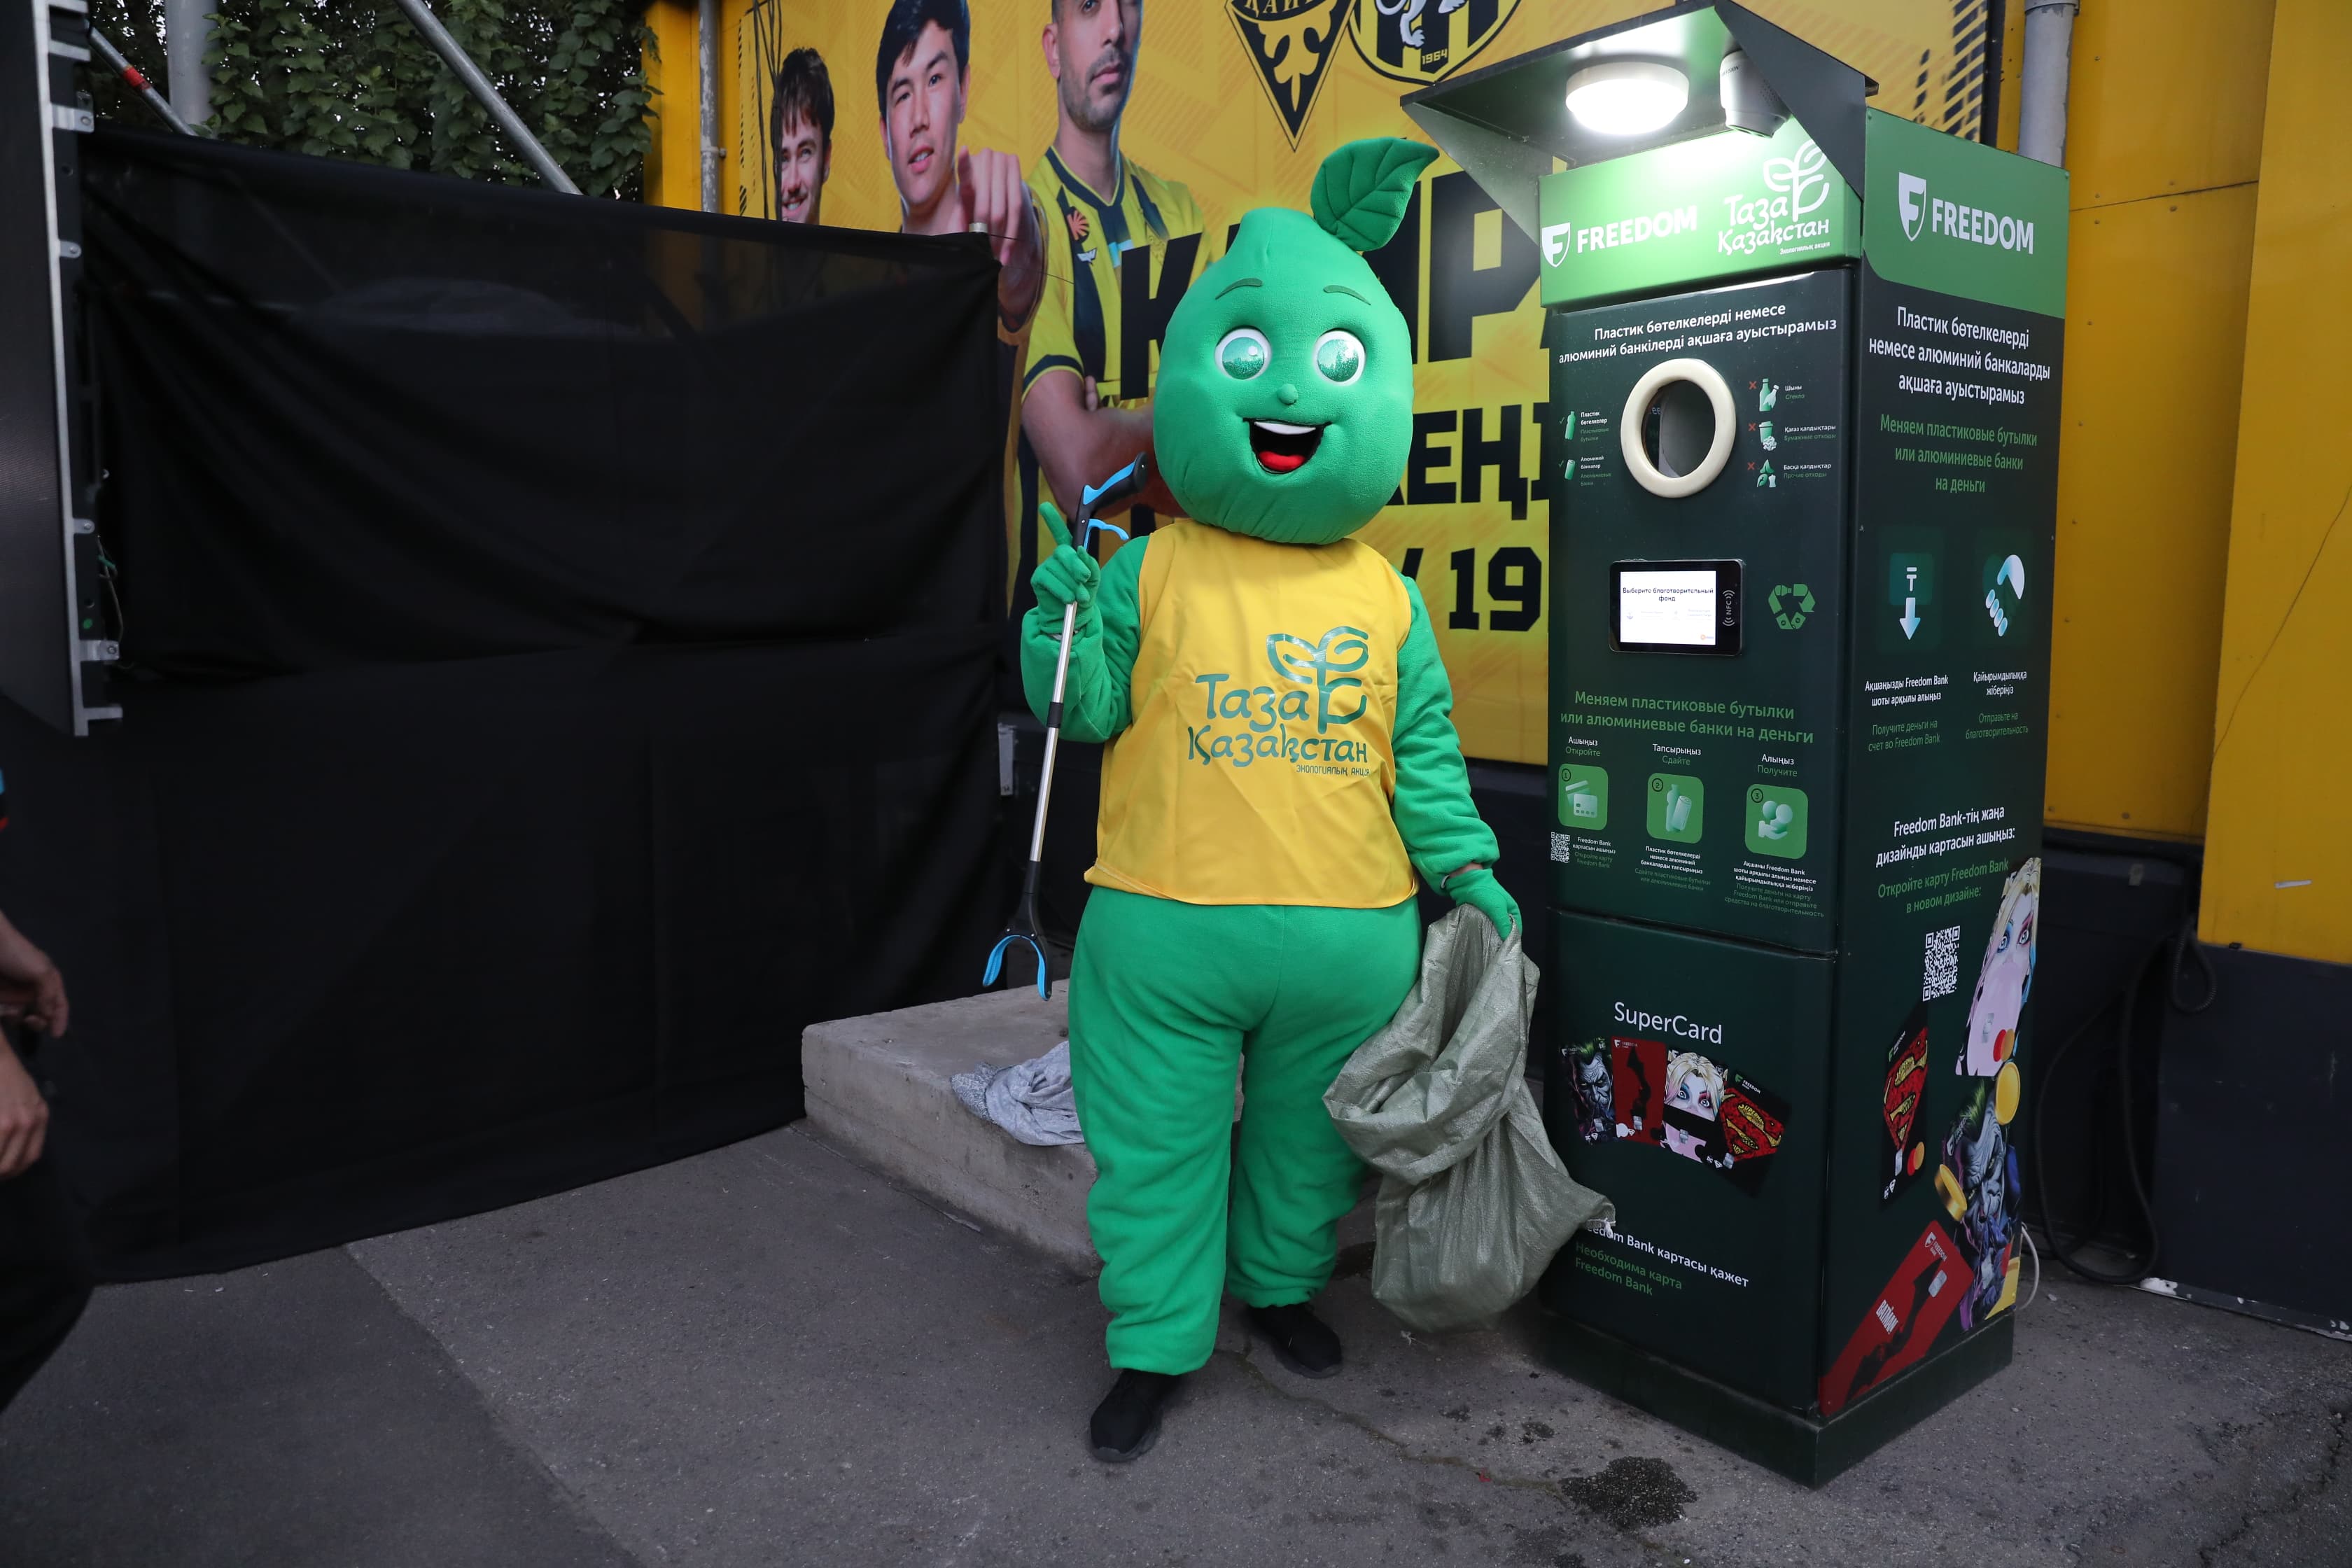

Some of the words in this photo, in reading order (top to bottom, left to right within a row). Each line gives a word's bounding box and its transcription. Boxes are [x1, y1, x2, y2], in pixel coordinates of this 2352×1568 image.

[1422, 48, 1448, 64] 1964
[1724, 195, 1788, 230] Таза
[1577, 206, 1698, 253] FREEDOM
[1718, 218, 1829, 255] Қазақстан
[1932, 197, 2033, 255] FREEDOM
[1595, 325, 1644, 341] Пластик
[1647, 309, 1732, 334] бөтелкелерді
[1735, 304, 1786, 321] немесе
[1897, 306, 1948, 335] Пластик
[1952, 316, 2029, 349] бөтелкелерді
[1559, 344, 1616, 363] алюминий
[1620, 337, 1684, 356] банкілерді
[1687, 331, 1733, 348] ақшаға
[1736, 318, 1837, 343] ауыстырамыз
[1869, 337, 1915, 358] немесе
[1918, 345, 1982, 369] алюминий
[1984, 351, 2050, 381] банкаларды
[1898, 374, 1942, 394] ақшаға
[1945, 381, 2024, 405] ауыстырамыз
[1880, 414, 1924, 435] Меняем
[1926, 422, 1995, 442] пластиковые
[1997, 427, 2038, 447] бутылки
[1895, 447, 1915, 462] или
[1917, 449, 1992, 468] алюминиевые
[1994, 452, 2023, 470] банки
[1935, 477, 1947, 491] на
[1950, 478, 1985, 493] деньги
[1865, 679, 1904, 692] Ақшаңызды
[1905, 675, 1933, 688] Freedom
[1933, 674, 1949, 686] Bank
[1973, 670, 2027, 684] Қайырымдылыққа
[1195, 673, 1310, 732] Таза
[1871, 696, 1890, 707] шоты
[1891, 693, 1917, 706] арқылы
[1917, 692, 1941, 702] алыңыз
[1986, 685, 2014, 697] жіберіңіз
[1574, 690, 1628, 708] Меняем
[1632, 697, 1726, 714] пластиковые
[1730, 701, 1795, 720] бутылки
[1560, 712, 1583, 725] или
[1586, 713, 1686, 732] алюминиевые
[1690, 720, 1733, 737] банки
[1737, 724, 1754, 738] на
[1758, 728, 1814, 745] деньги
[1872, 724, 1905, 737] Получите
[1906, 720, 1929, 734] деньги
[1930, 720, 1938, 729] на
[1978, 712, 2010, 726] Отправьте
[2010, 712, 2018, 720] на
[1568, 736, 1598, 748] Ашыңыз
[1868, 741, 1884, 752] счет
[1885, 740, 1893, 750] во
[1895, 734, 1924, 748] Freedom
[1925, 734, 1940, 745] Bank
[1966, 724, 2029, 740] благотворительность
[1188, 723, 1368, 767] Қазақстан
[1565, 746, 1601, 757] Откройте
[1653, 743, 1702, 757] Тапсырыңыз
[1662, 755, 1691, 766] Сдайте
[1757, 764, 1798, 778] Получите
[1761, 753, 1795, 766] Алыңыз
[1893, 816, 1937, 837] Freedom
[1940, 807, 1980, 830] Bank-тің
[1981, 806, 2005, 822] жаңа
[1646, 846, 1666, 854] Пластик
[1876, 845, 1926, 868] дизайнды
[1928, 834, 1974, 856] картасын
[1976, 827, 2015, 845] ашыңыз:
[1641, 860, 1671, 869] банкаларды
[1669, 857, 1695, 865] алюминий
[1766, 864, 1790, 874] Freedom
[1736, 883, 1764, 893] Получите
[1878, 876, 1923, 898] Откройте
[1924, 872, 1949, 890] карту
[1951, 862, 1987, 882] Freedom
[1989, 857, 2009, 873] Bank
[1733, 890, 1758, 899] Freedom
[1906, 902, 1912, 913] в
[1914, 893, 1942, 912] новом
[1944, 886, 1982, 906] дизайне:
[1614, 1001, 1722, 1045] SuperCard
[1576, 1242, 1646, 1276] Необходима
[1649, 1270, 1682, 1290] карта
[1627, 1234, 1655, 1254] Bank
[1657, 1247, 1707, 1273] картасы
[1710, 1266, 1749, 1288] қажет
[1575, 1257, 1622, 1284] Freedom
[1625, 1275, 1653, 1296] Bank
